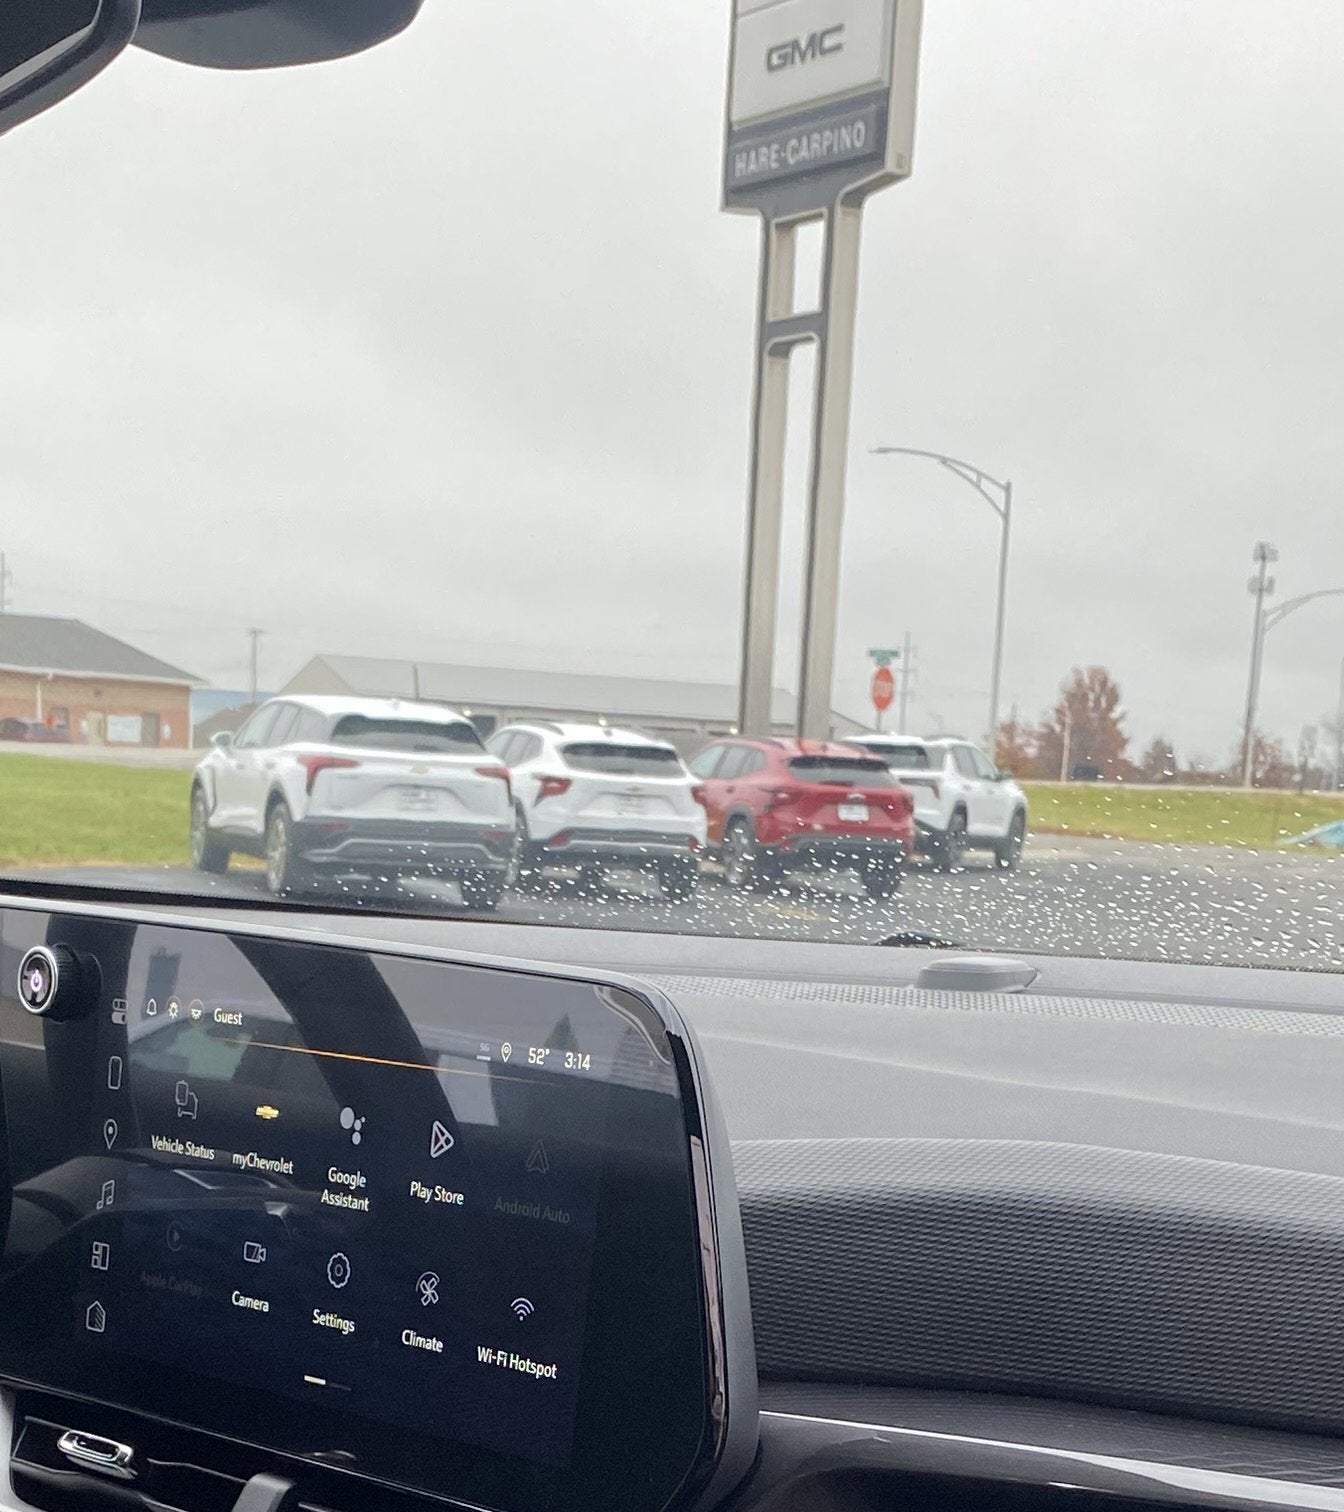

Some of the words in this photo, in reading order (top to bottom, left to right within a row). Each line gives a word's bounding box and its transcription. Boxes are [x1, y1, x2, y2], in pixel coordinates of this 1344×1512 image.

[767, 23, 845, 72] GMC
[735, 121, 865, 177] HARE-CARPINO
[214, 1008, 242, 1026] Guest
[528, 1048, 550, 1064] 52°
[565, 1052, 591, 1070] 3:14
[151, 1135, 184, 1155] Vehicle
[186, 1141, 215, 1160] Status
[233, 1152, 293, 1175] myChevrolet
[328, 1167, 366, 1189] Google
[321, 1189, 370, 1212] Assistant
[410, 1181, 433, 1203] Play
[434, 1186, 464, 1205] Store
[495, 1199, 539, 1219] Android
[542, 1206, 570, 1224] Auto
[232, 1291, 269, 1313] Camera
[312, 1308, 355, 1335] Settings
[402, 1329, 444, 1353] Climate
[478, 1345, 508, 1367] Wi-Fi
[509, 1354, 557, 1380] Hotspot
